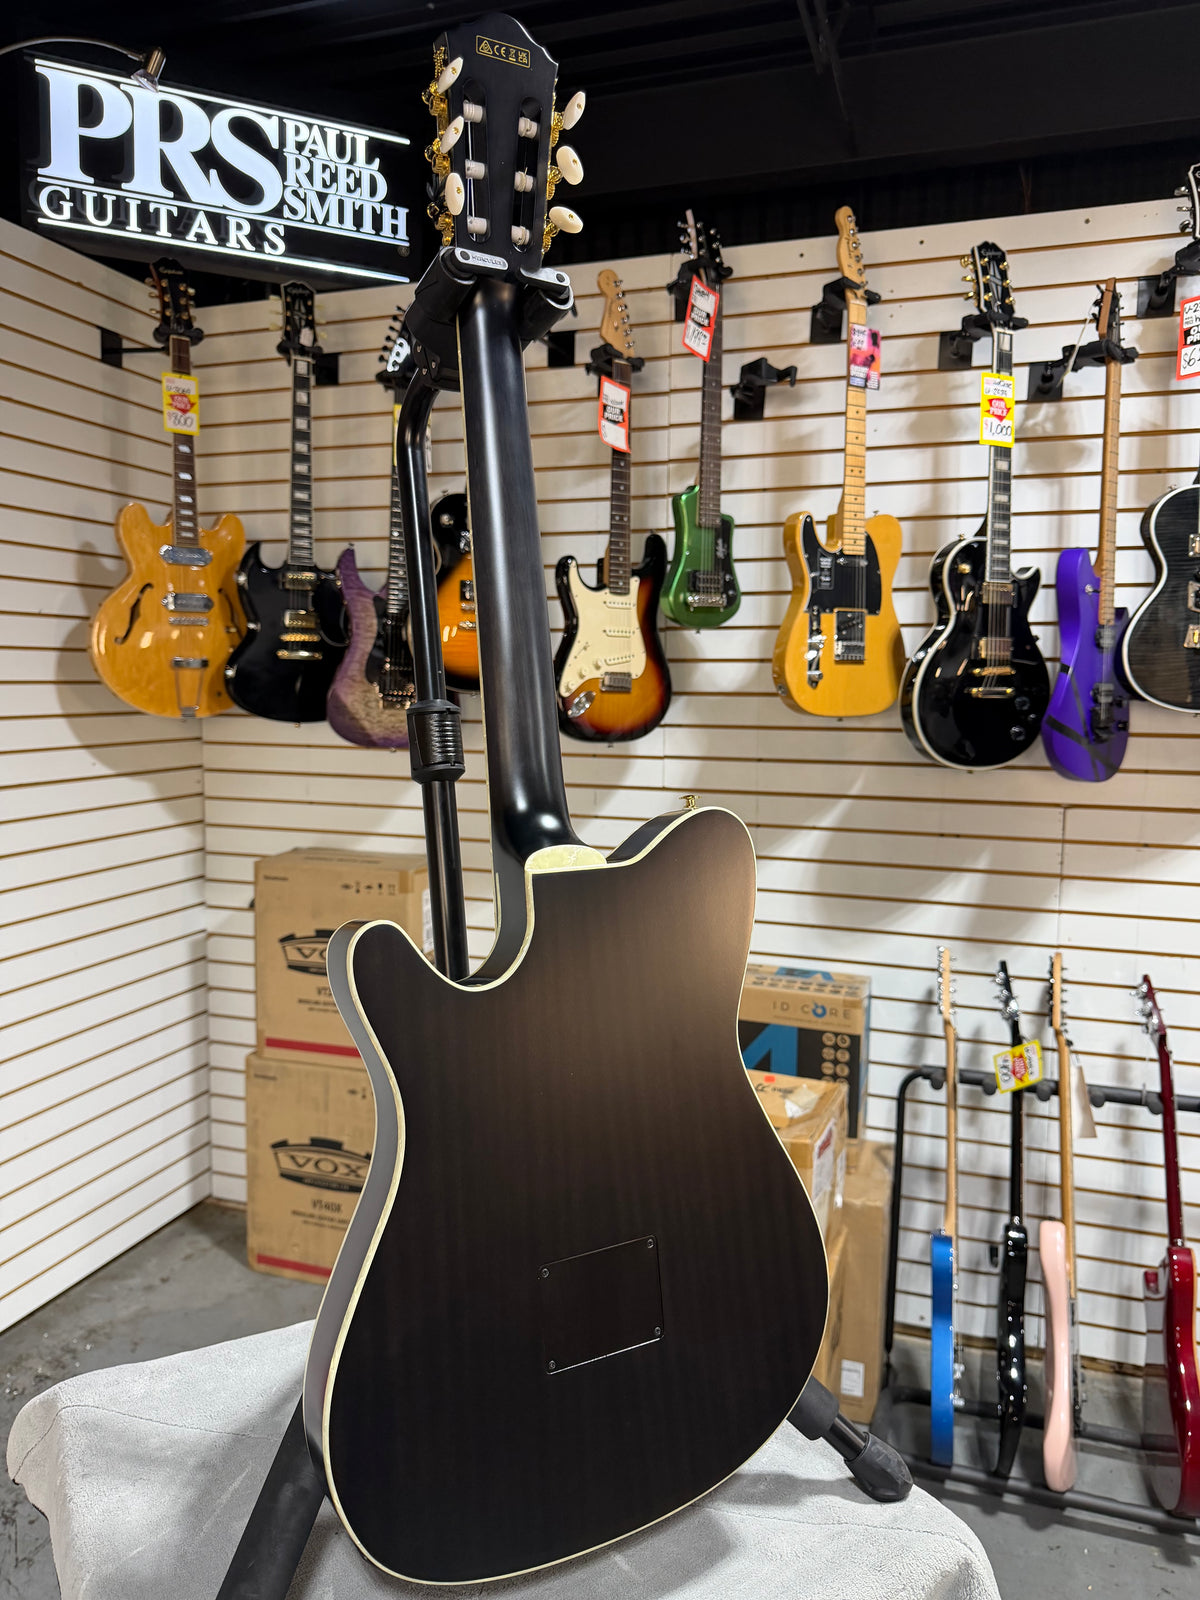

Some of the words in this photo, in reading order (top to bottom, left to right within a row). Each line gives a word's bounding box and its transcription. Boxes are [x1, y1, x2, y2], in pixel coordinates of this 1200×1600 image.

[35, 65, 283, 214] PRS
[283, 118, 380, 171] PAUL
[284, 152, 388, 202] REED
[38, 186, 286, 256] GUITARS
[283, 187, 409, 241] SMITH
[772, 1001, 790, 1013] ID
[800, 1002, 852, 1020] CORE
[289, 1153, 369, 1178] VOX
